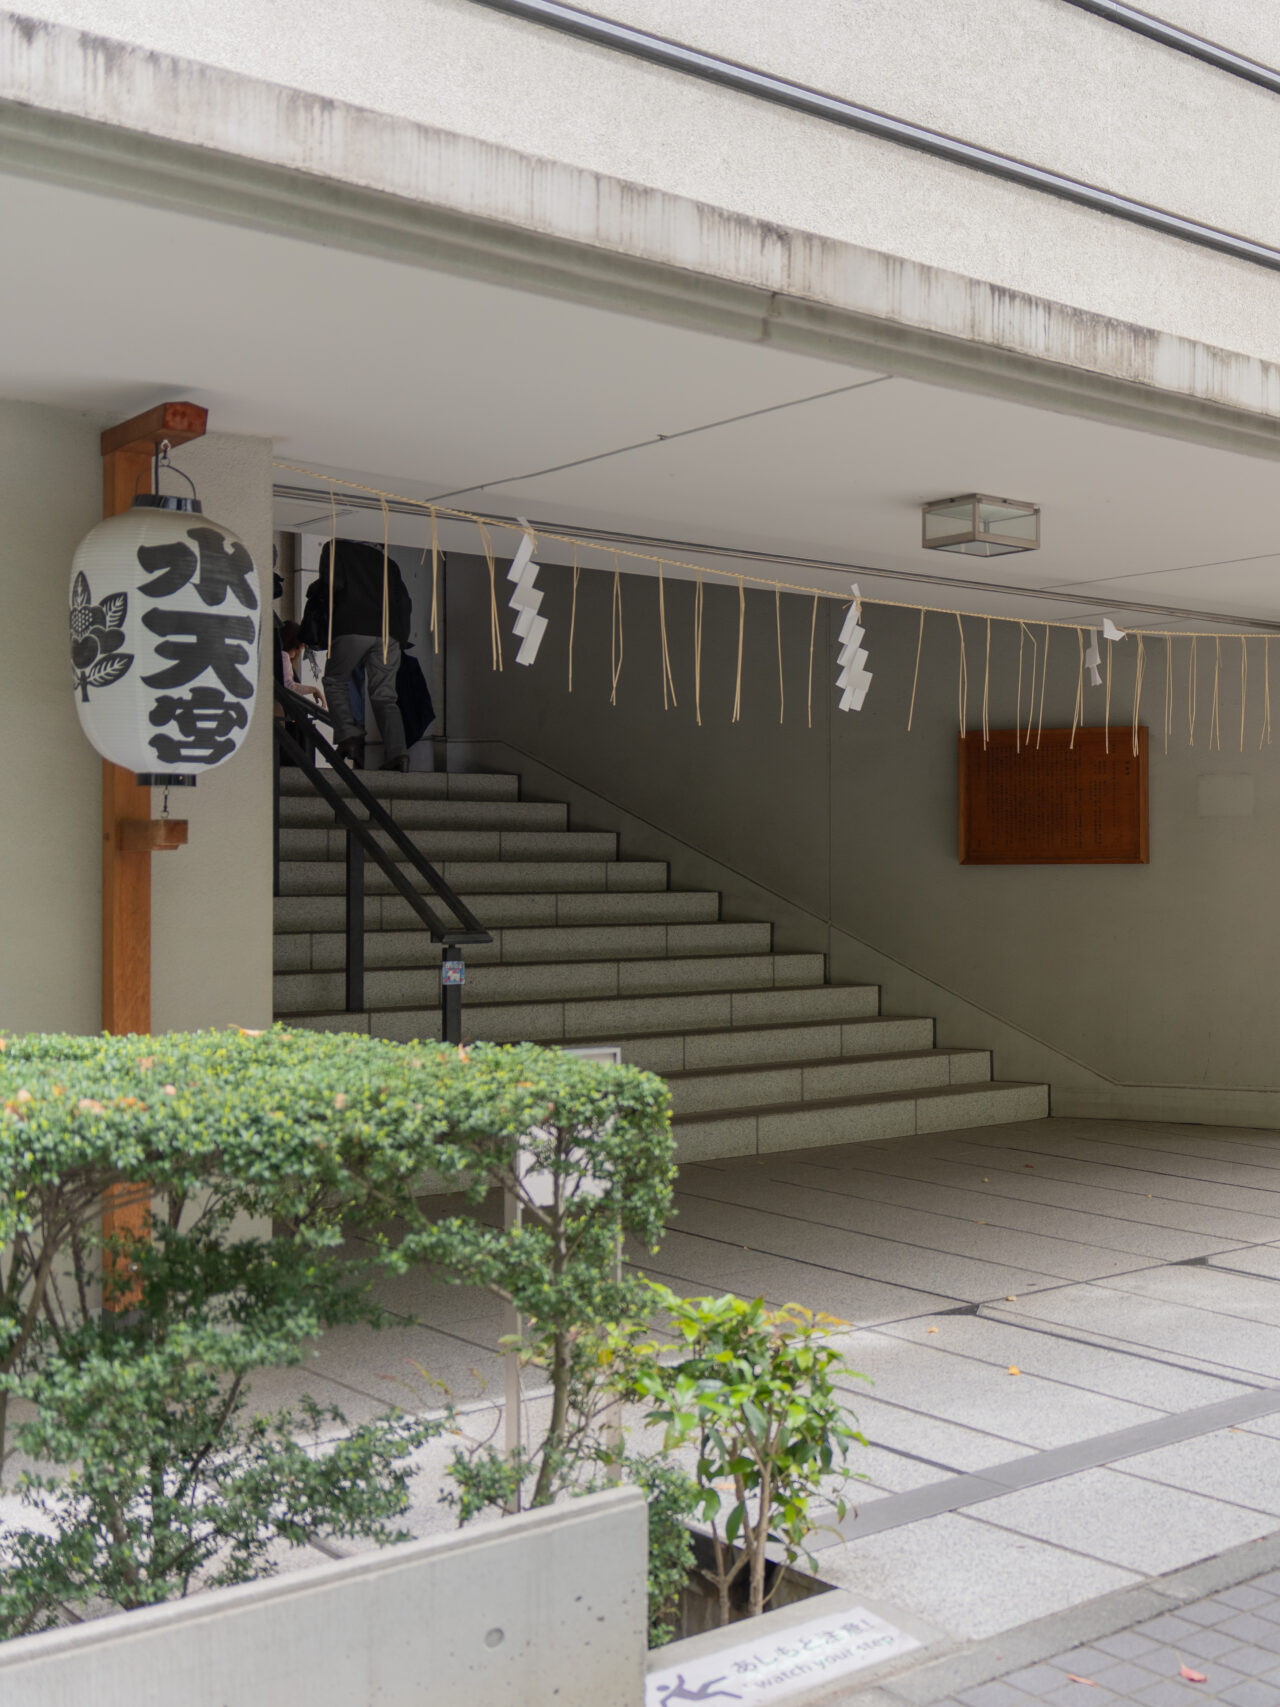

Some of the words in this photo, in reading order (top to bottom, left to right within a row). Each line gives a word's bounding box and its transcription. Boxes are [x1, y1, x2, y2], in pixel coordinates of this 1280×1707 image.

[137, 527, 258, 765] 水天宮
[813, 1648, 854, 1670] your
[855, 1634, 895, 1652] step
